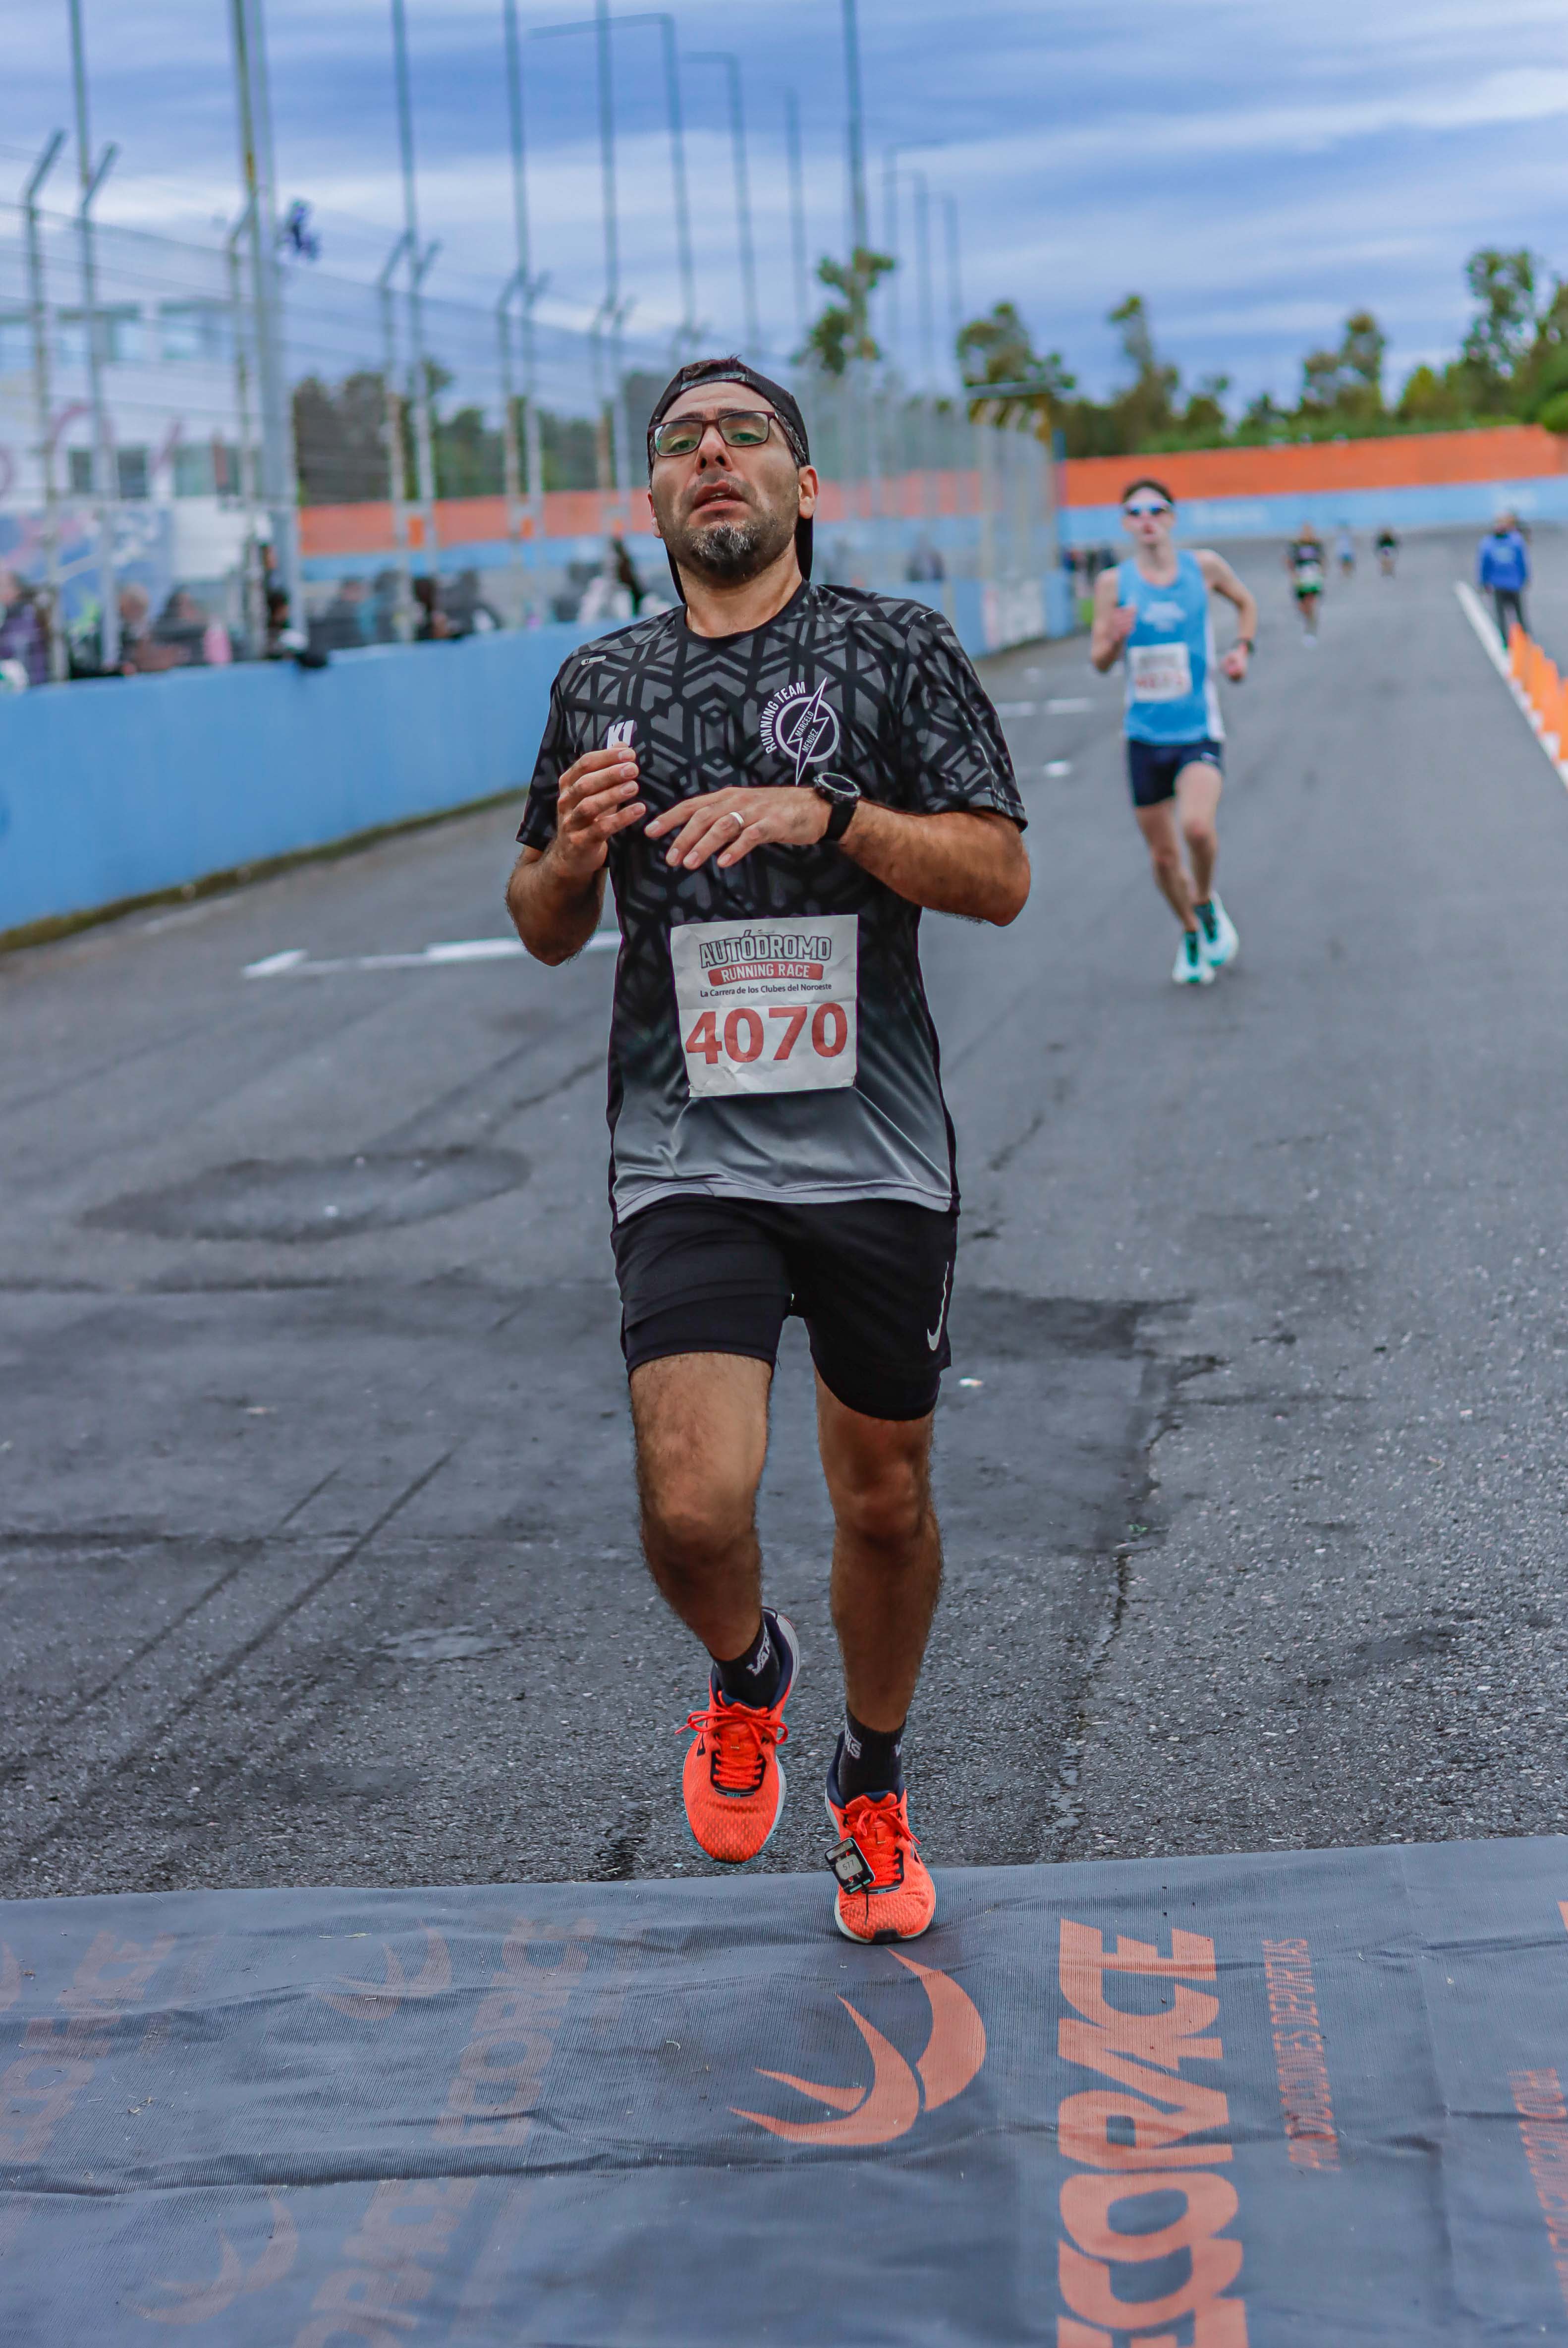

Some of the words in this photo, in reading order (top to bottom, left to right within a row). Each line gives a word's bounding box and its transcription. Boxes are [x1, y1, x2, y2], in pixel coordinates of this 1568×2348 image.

[760, 701, 779, 754] RUNNING
[774, 681, 806, 703] TEAM
[794, 711, 814, 737] MARCELO
[802, 728, 819, 753] MENDEZ
[699, 929, 832, 968] AUTÓDROMO
[721, 963, 774, 983] RUNNING
[779, 963, 810, 978] RACE
[760, 984, 785, 993] Clubes
[685, 1002, 848, 1064] 4070
[842, 1860, 854, 1870] 577
